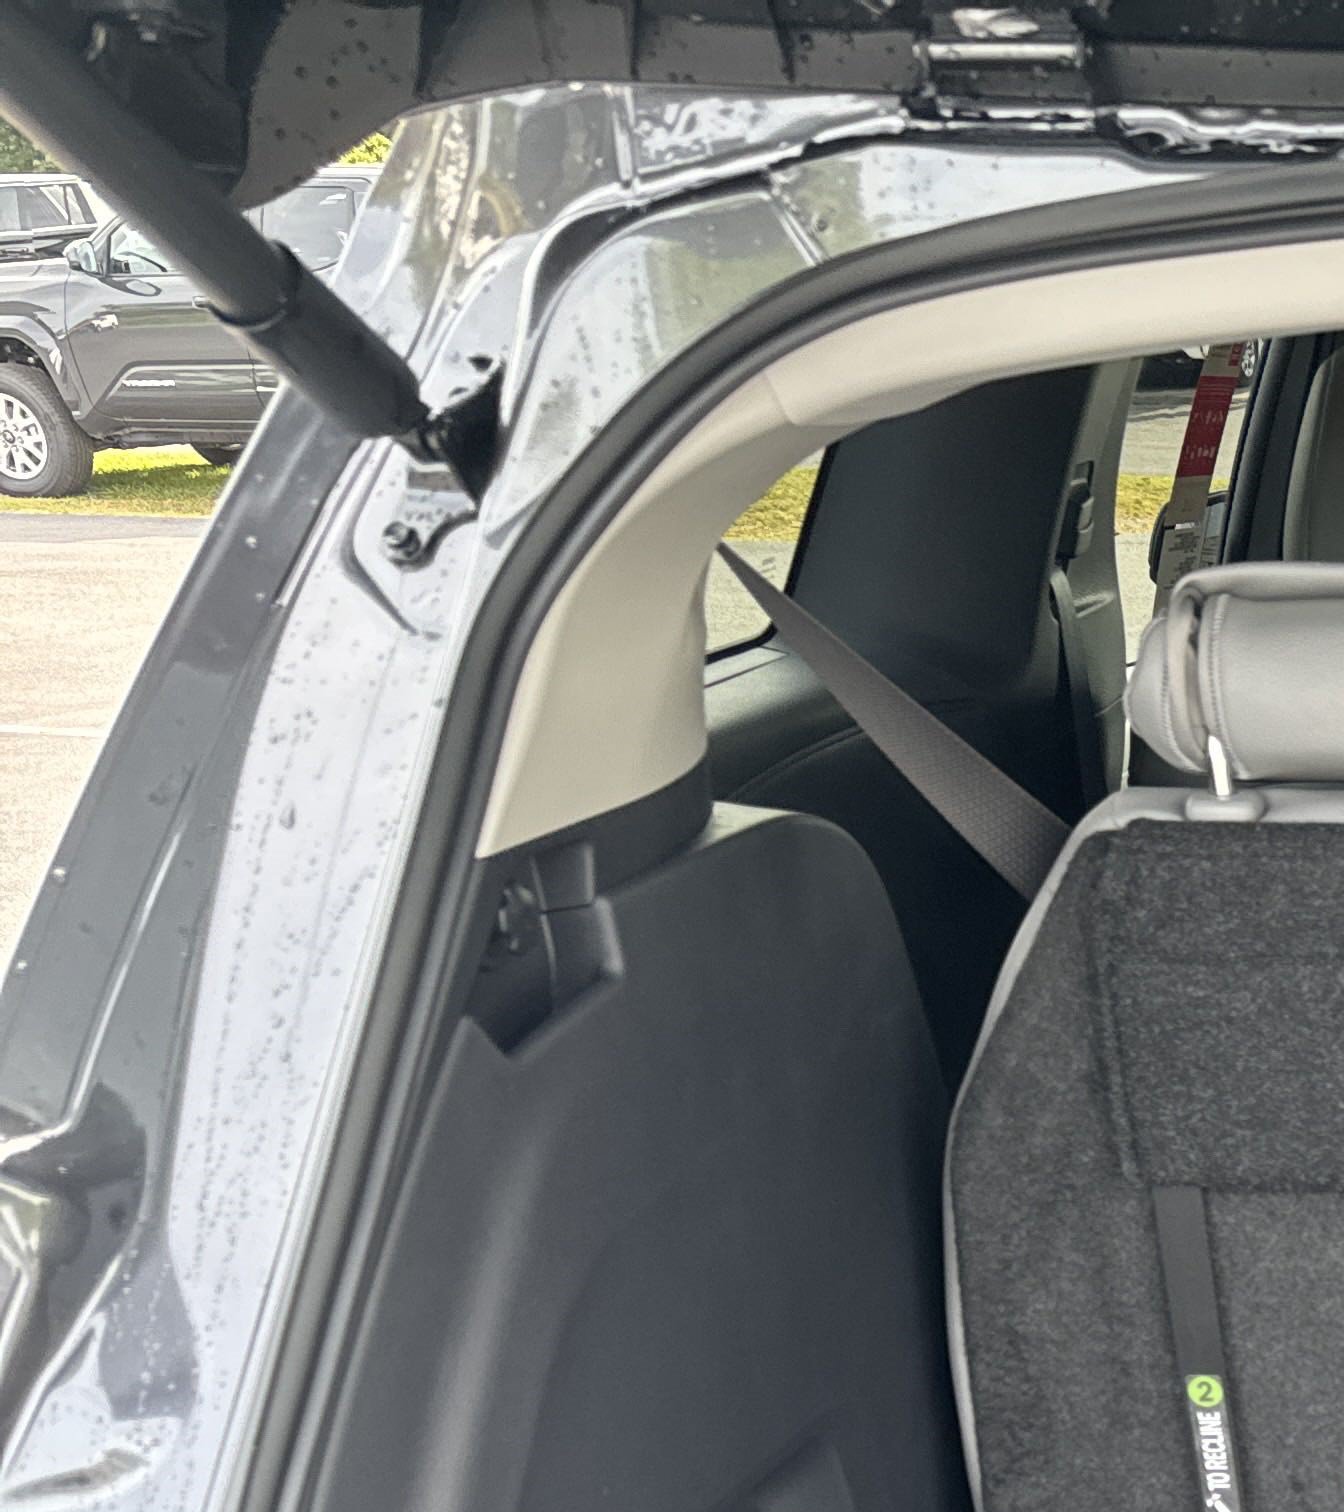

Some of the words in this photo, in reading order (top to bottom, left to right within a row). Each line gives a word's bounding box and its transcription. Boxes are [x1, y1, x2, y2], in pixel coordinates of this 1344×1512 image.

[1196, 1381, 1215, 1403] 2
[1196, 1411, 1229, 1471] RECLINE
[1206, 1472, 1231, 1492] TO
